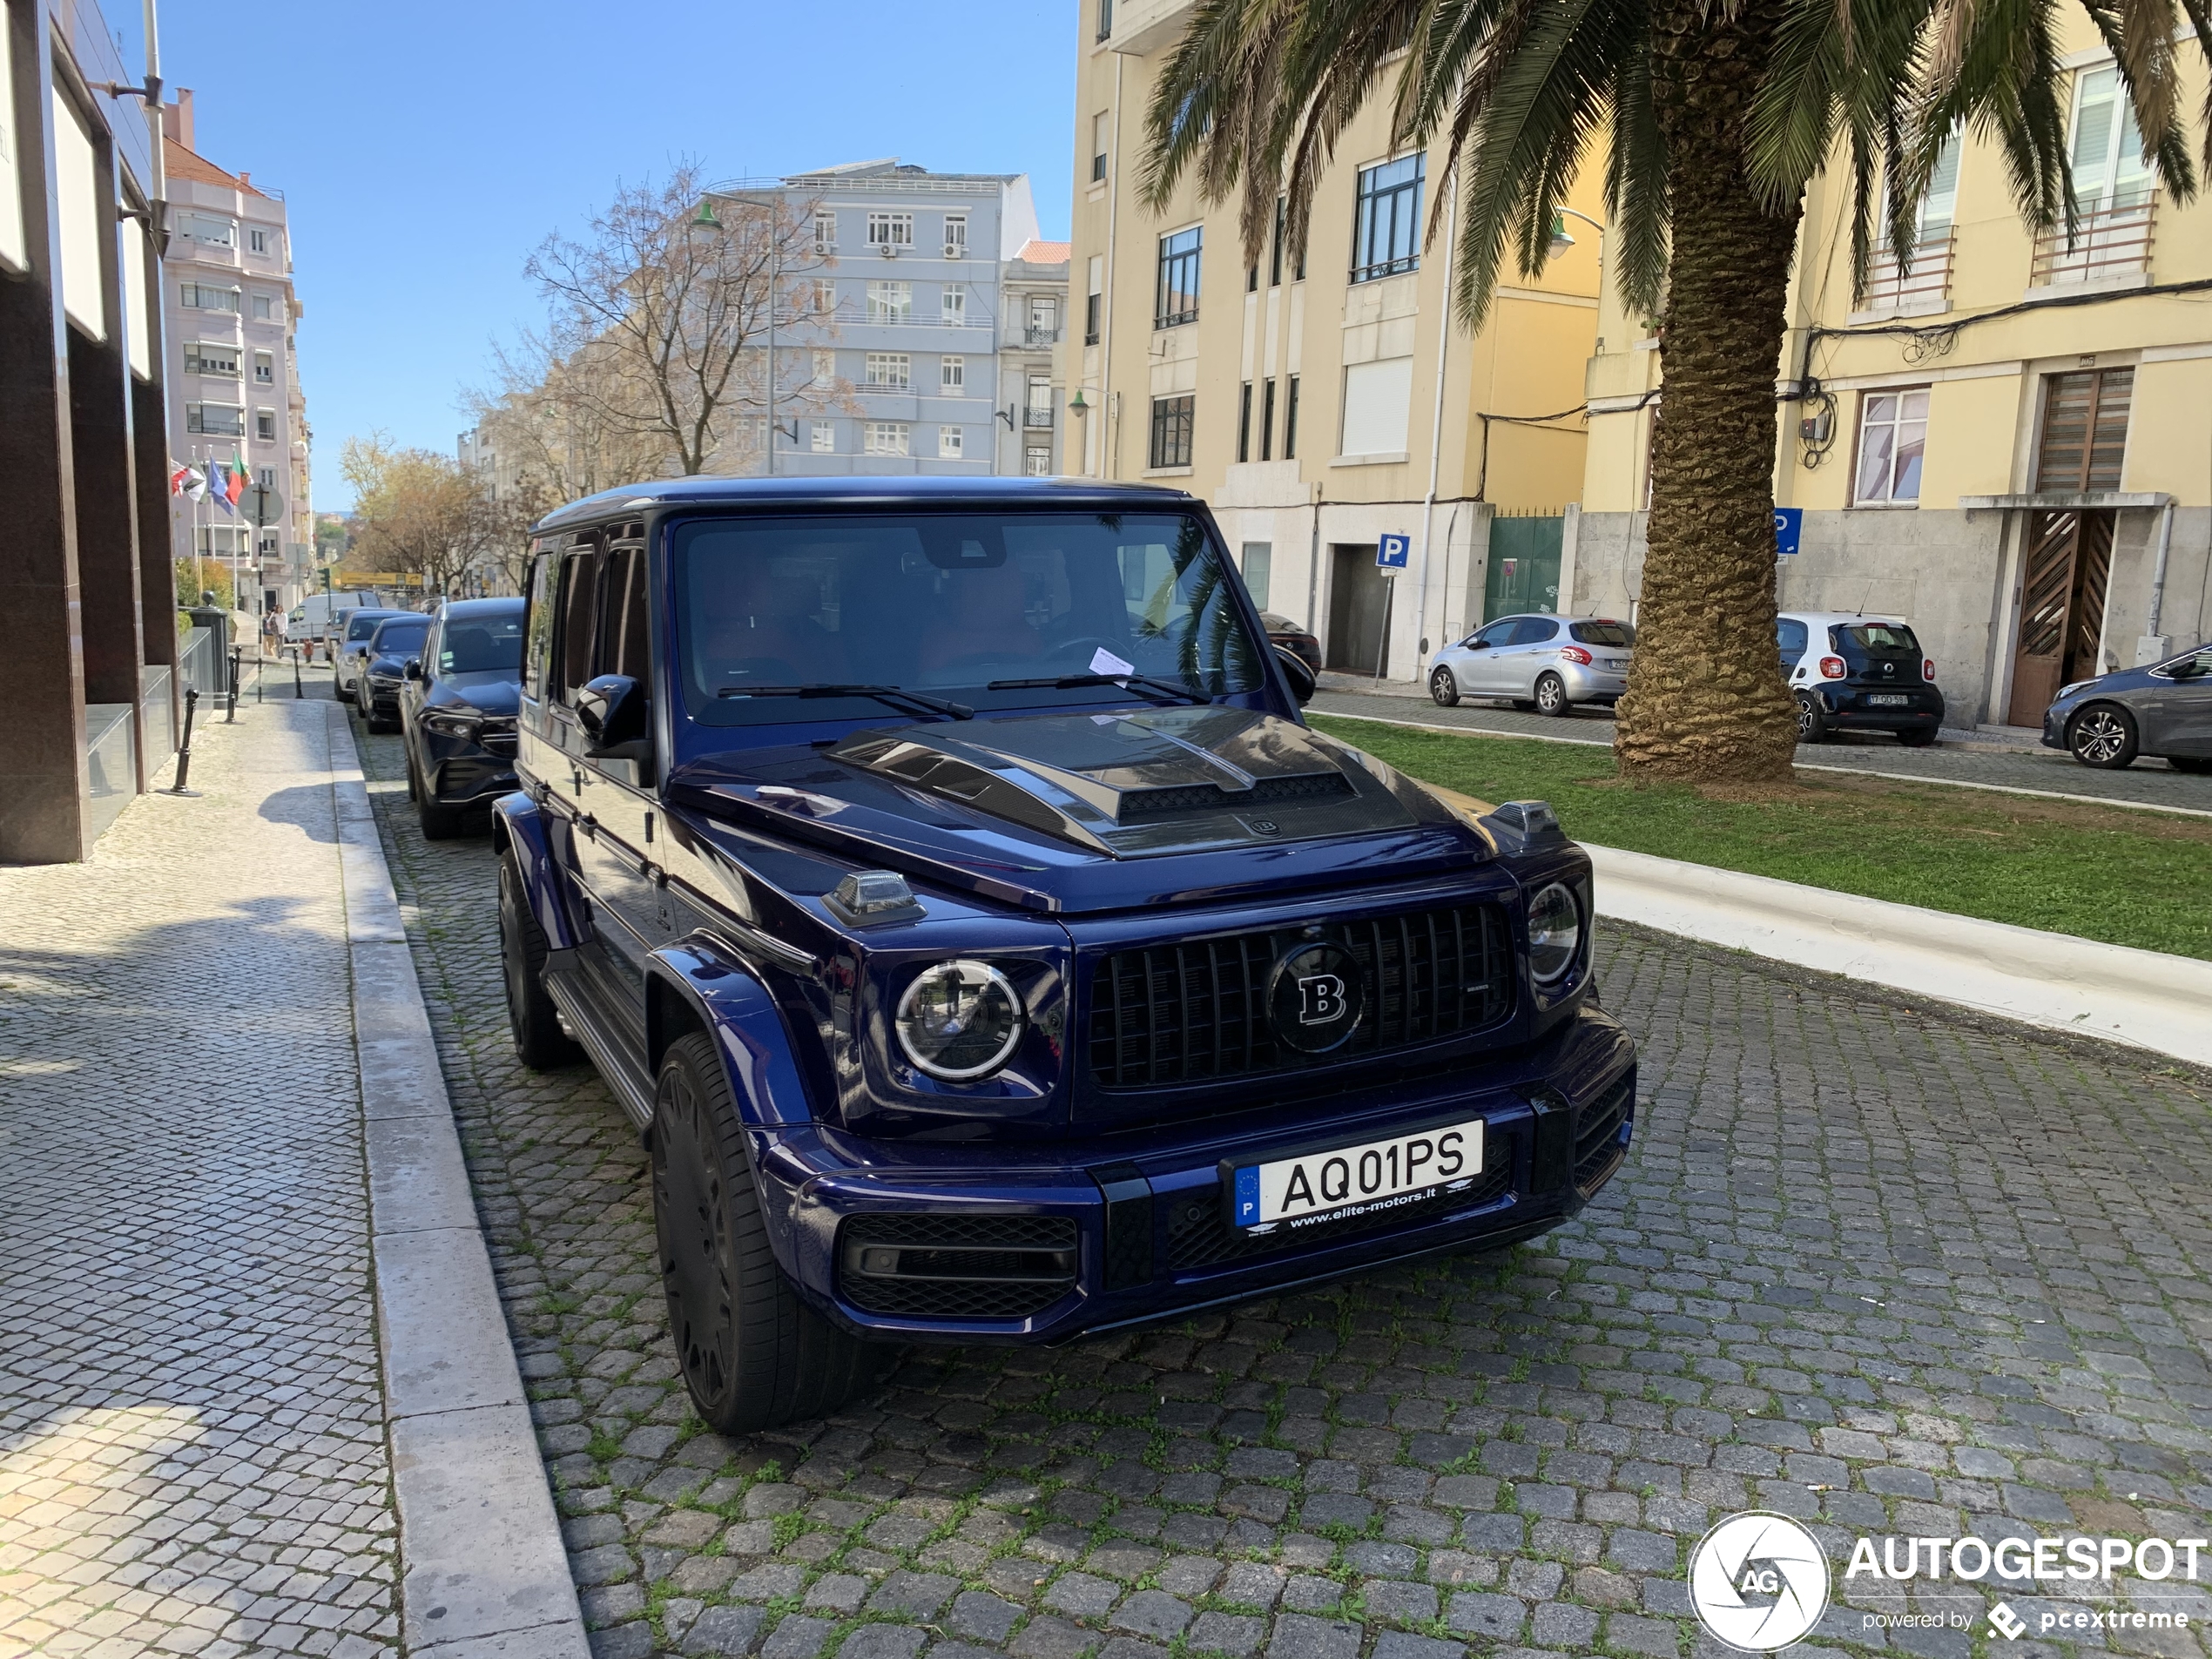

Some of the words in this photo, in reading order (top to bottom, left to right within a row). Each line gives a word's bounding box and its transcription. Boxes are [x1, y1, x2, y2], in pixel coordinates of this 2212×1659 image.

[1383, 537, 1403, 563] P
[1298, 974, 1347, 1026] B
[1243, 1202, 1253, 1216] P
[1290, 1187, 1437, 1228] www.elite-motors.lt
